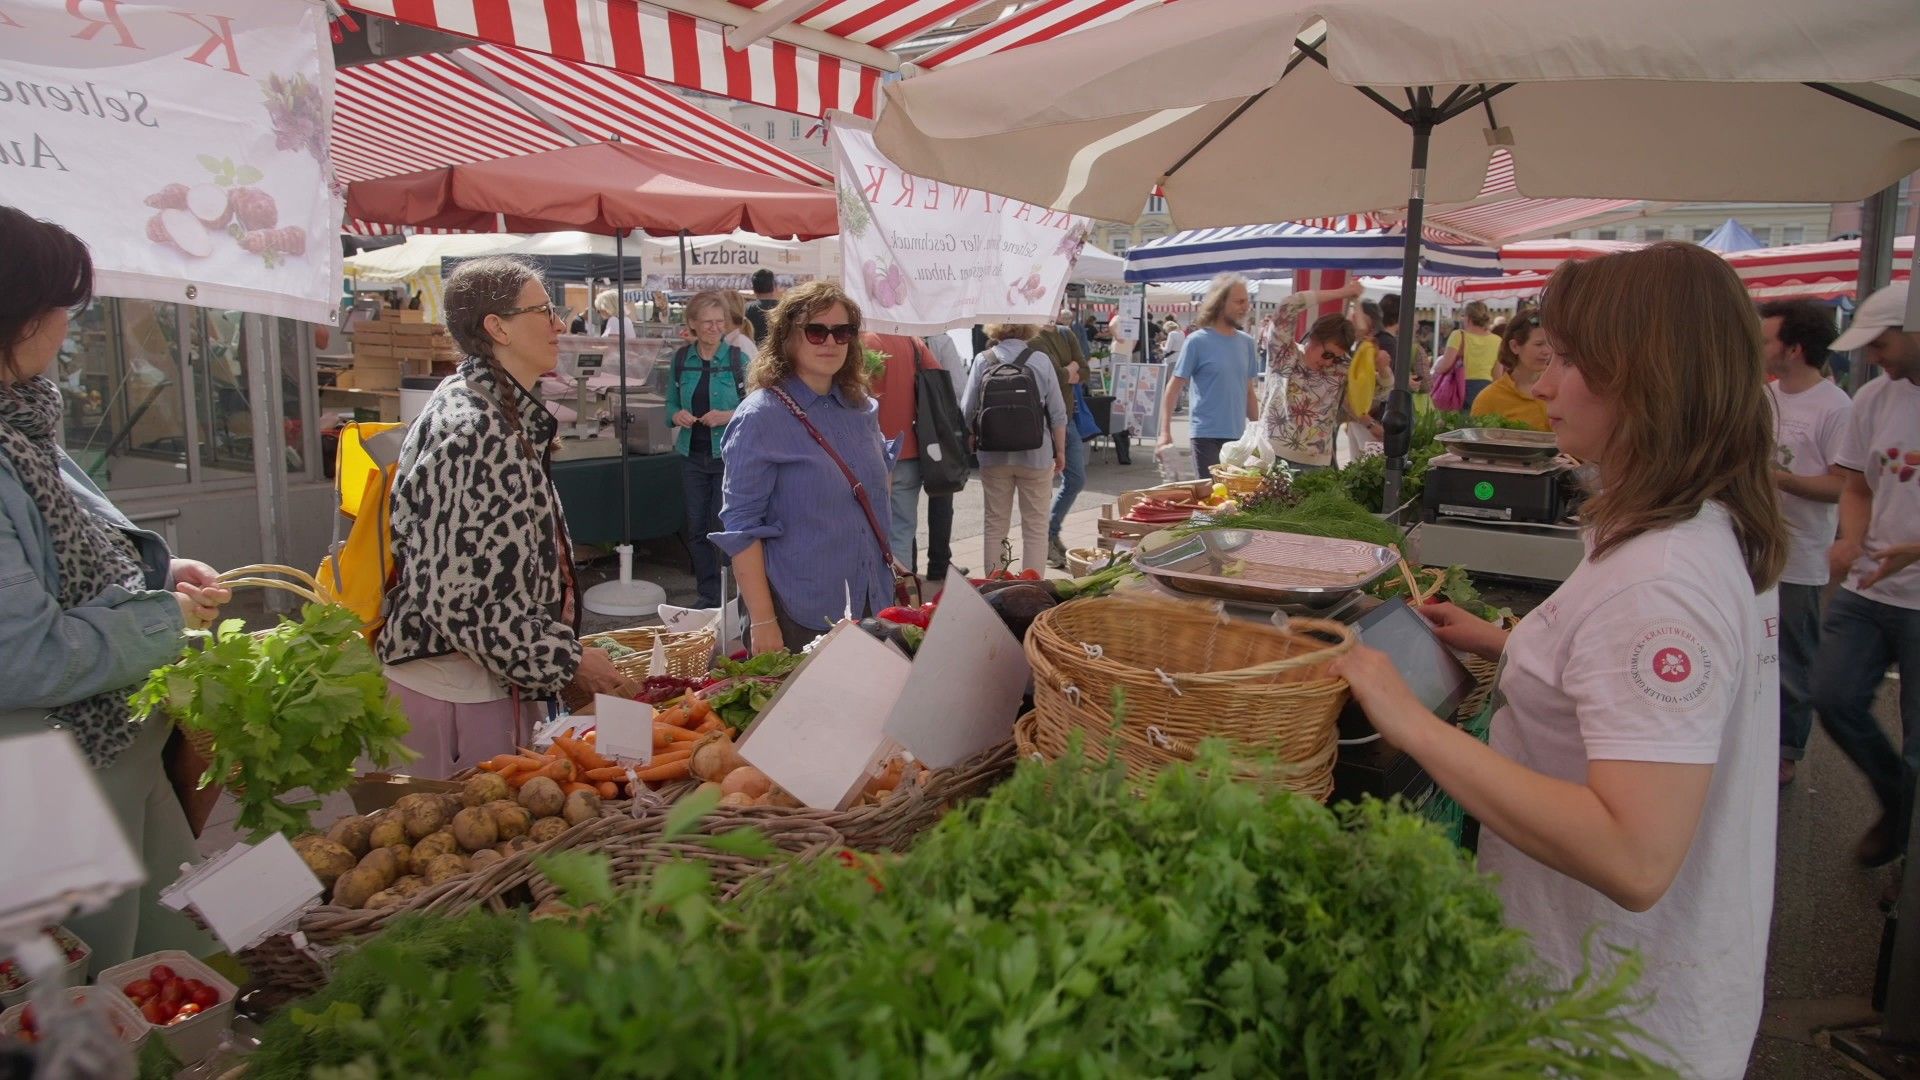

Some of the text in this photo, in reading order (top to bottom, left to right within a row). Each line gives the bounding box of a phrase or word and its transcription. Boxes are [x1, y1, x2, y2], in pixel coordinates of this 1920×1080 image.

[691, 245, 760, 265] Erzbräu
[1644, 627, 1696, 645] KRAUTWERK
[1631, 643, 1679, 704] VOLLER GESCHMACK
[1682, 682, 1708, 702] SORTEN
